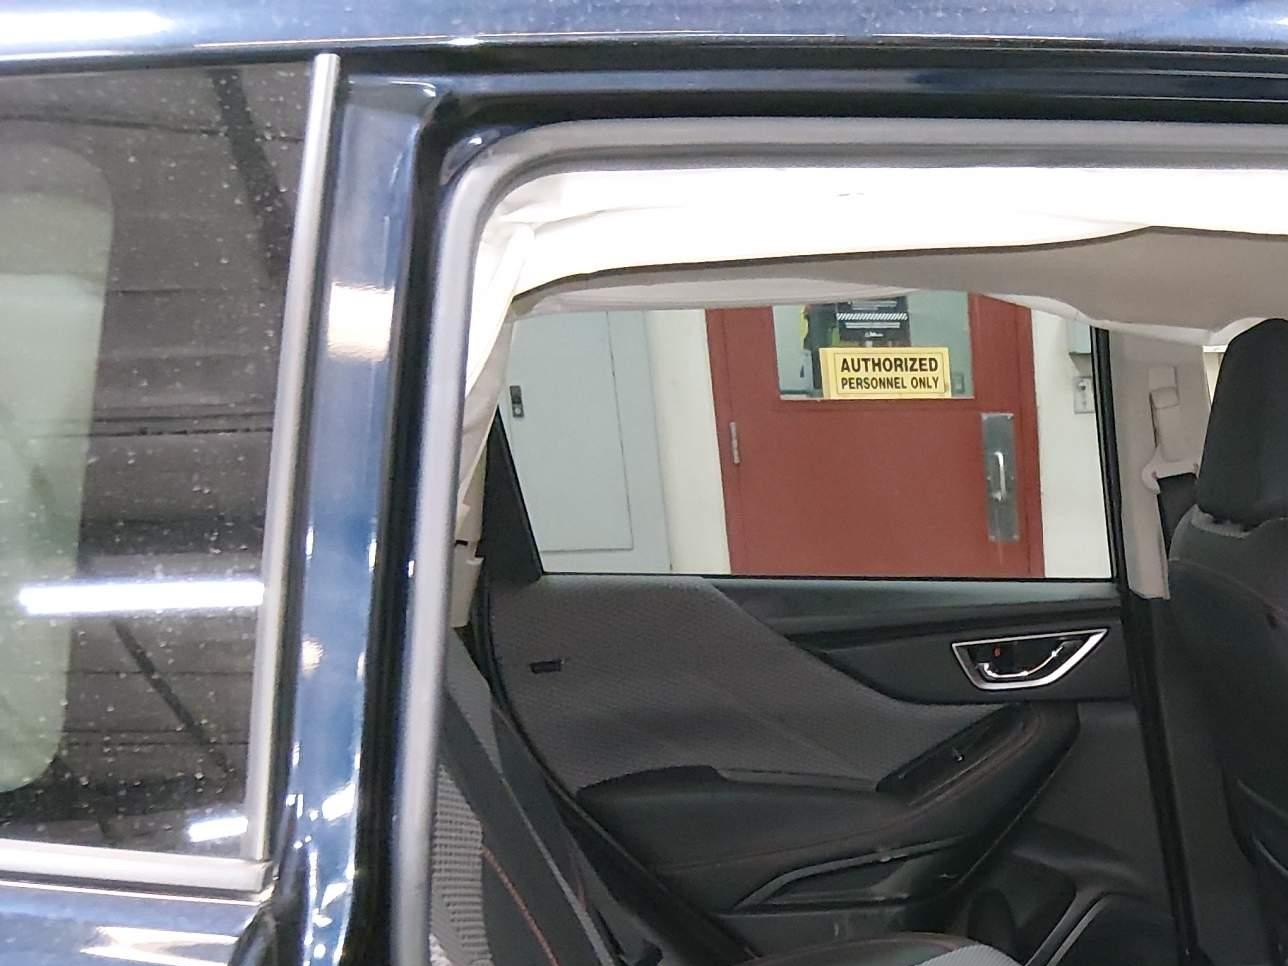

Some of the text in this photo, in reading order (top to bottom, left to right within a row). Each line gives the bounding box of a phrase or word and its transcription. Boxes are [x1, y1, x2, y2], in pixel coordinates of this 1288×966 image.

[840, 357, 938, 373] AUTHORIZED
[841, 376, 939, 390] PERSONNEL ONLY
